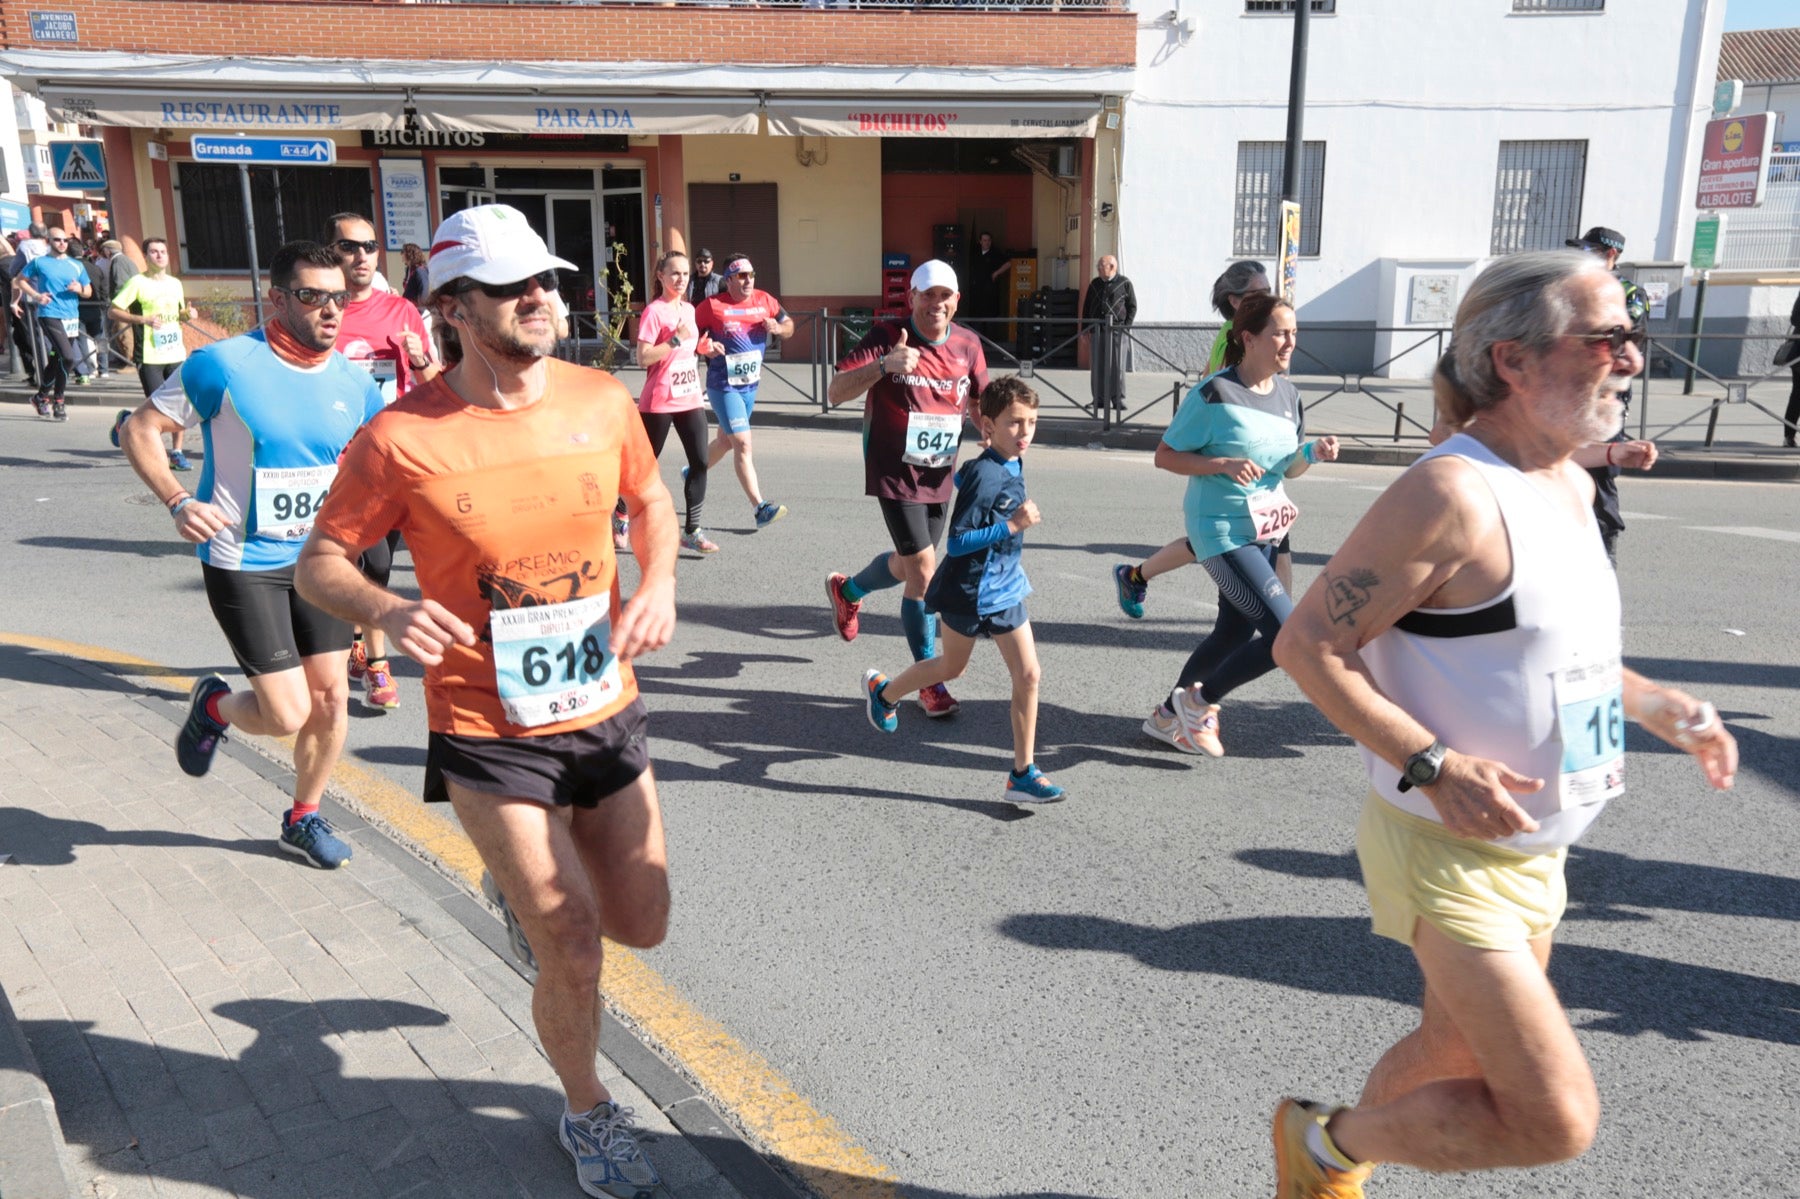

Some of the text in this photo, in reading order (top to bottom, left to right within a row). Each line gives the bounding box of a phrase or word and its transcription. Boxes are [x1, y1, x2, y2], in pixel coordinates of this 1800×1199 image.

[44, 21, 72, 30] JACOBO
[35, 30, 76, 40] CAMARERO
[160, 102, 342, 125] RESTAURANTE
[535, 107, 635, 128] PARADA
[373, 129, 485, 147] BICHITOS
[196, 143, 308, 156] Granada A-44
[1702, 156, 1760, 172] Gran apertura
[1700, 192, 1752, 207] ALBOLOTE
[160, 332, 178, 345] 328
[734, 361, 757, 375] 596
[917, 431, 954, 451] 647
[505, 550, 581, 574] PREMIO
[527, 609, 551, 624] GRAN
[522, 634, 604, 687] 618
